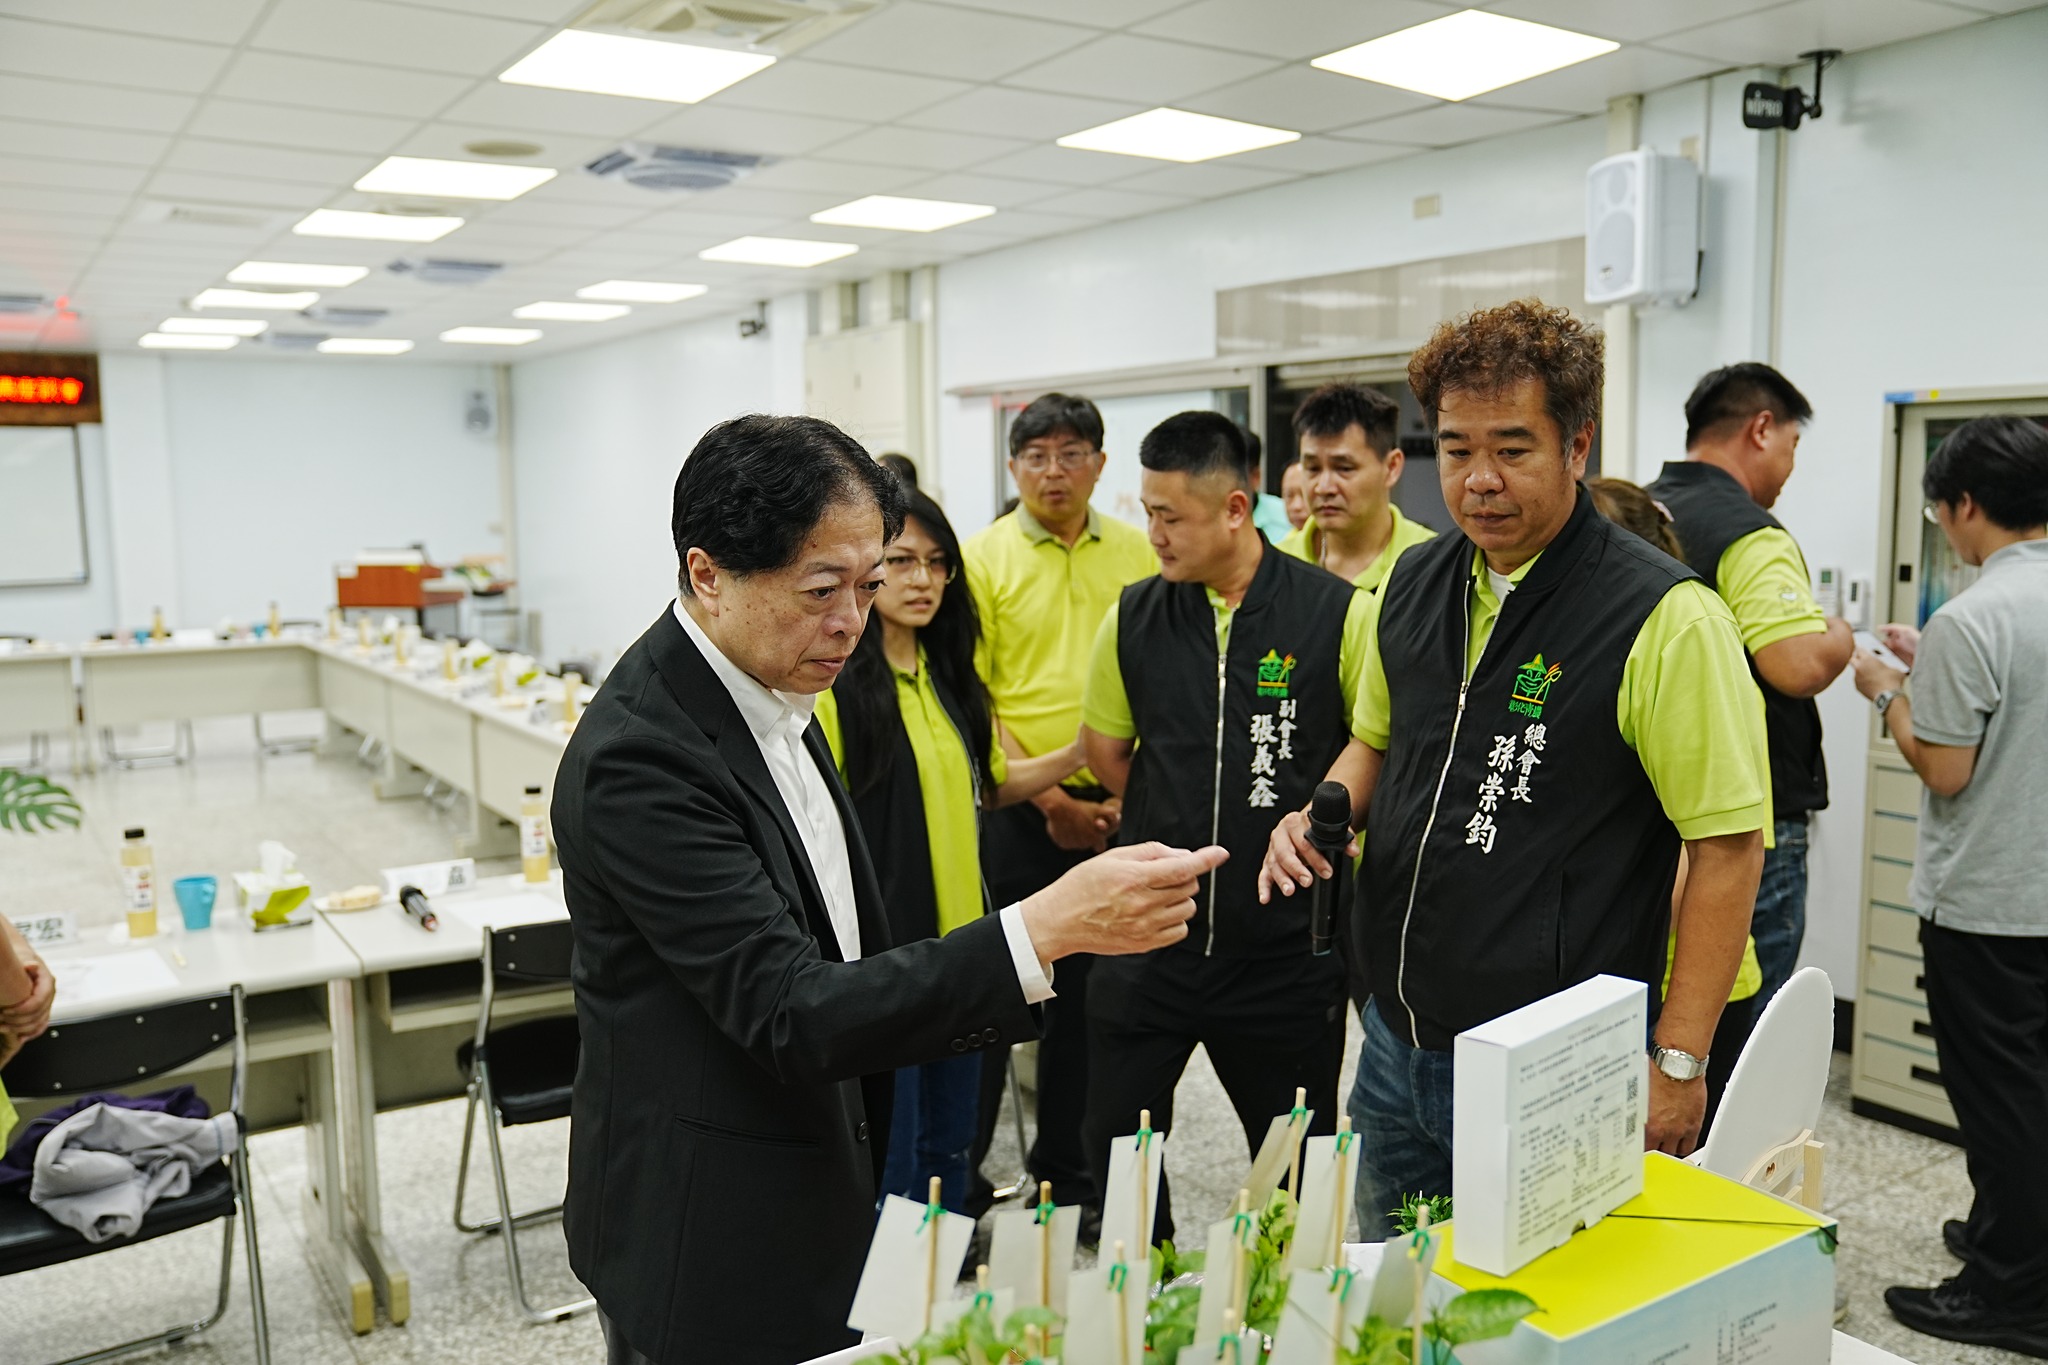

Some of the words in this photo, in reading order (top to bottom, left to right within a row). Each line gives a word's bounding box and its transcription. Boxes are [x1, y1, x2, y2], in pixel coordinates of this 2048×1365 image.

[1248, 713, 1279, 808] 張義鑫
[1277, 698, 1297, 760] 副會長
[1510, 722, 1547, 803] 總會長
[1465, 734, 1517, 855] 孫崇鈞
